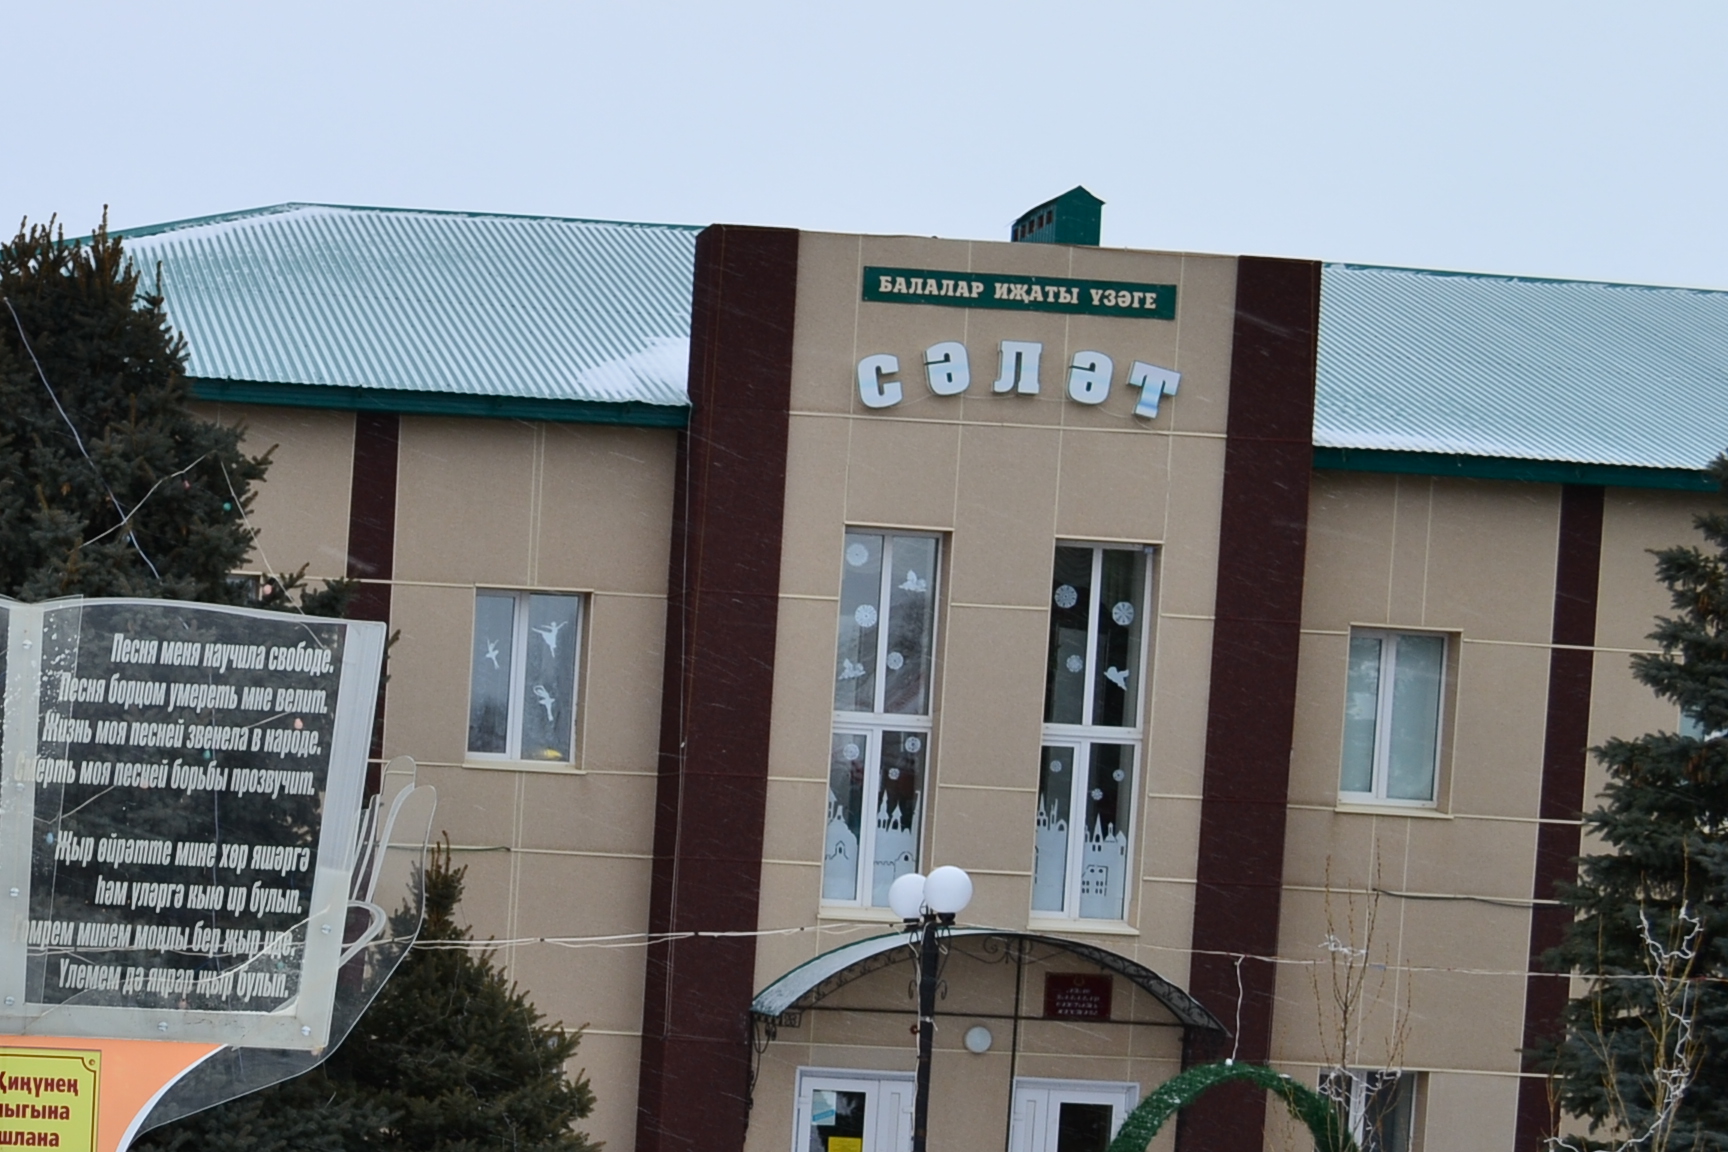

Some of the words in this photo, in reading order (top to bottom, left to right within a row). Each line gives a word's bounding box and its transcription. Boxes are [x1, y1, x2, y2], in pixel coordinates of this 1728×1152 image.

[878, 275, 985, 299] БАЛАЛАР
[994, 282, 1080, 305] ИҖАТЫ
[1089, 289, 1157, 310] ҮЗӘГЕ
[110, 633, 158, 664] Песня
[160, 640, 201, 666] меня
[203, 643, 266, 673] научила
[268, 641, 333, 676] свободе.
[59, 672, 105, 703] Песня
[108, 673, 166, 710] борцом
[168, 681, 238, 713] умереть
[241, 687, 272, 711] мне
[275, 687, 327, 714] велит.
[42, 711, 92, 744] Жизнь
[95, 721, 128, 745] моя
[129, 719, 185, 749] песней
[186, 724, 248, 751] звенела
[251, 728, 262, 752] в
[264, 728, 321, 758] народе.
[79, 760, 111, 785] моя
[114, 759, 169, 788] песней
[171, 758, 227, 795] борьбы
[230, 767, 315, 799] прозвучит.
[175, 842, 217, 867] мине
[251, 845, 310, 876] яшәргә
[187, 884, 224, 911] кыю
[227, 886, 247, 917] ир
[250, 881, 302, 918] булып.
[77, 921, 131, 948] минем
[192, 921, 221, 958] бер
[123, 966, 144, 994] дә
[236, 965, 289, 1002] булып.
